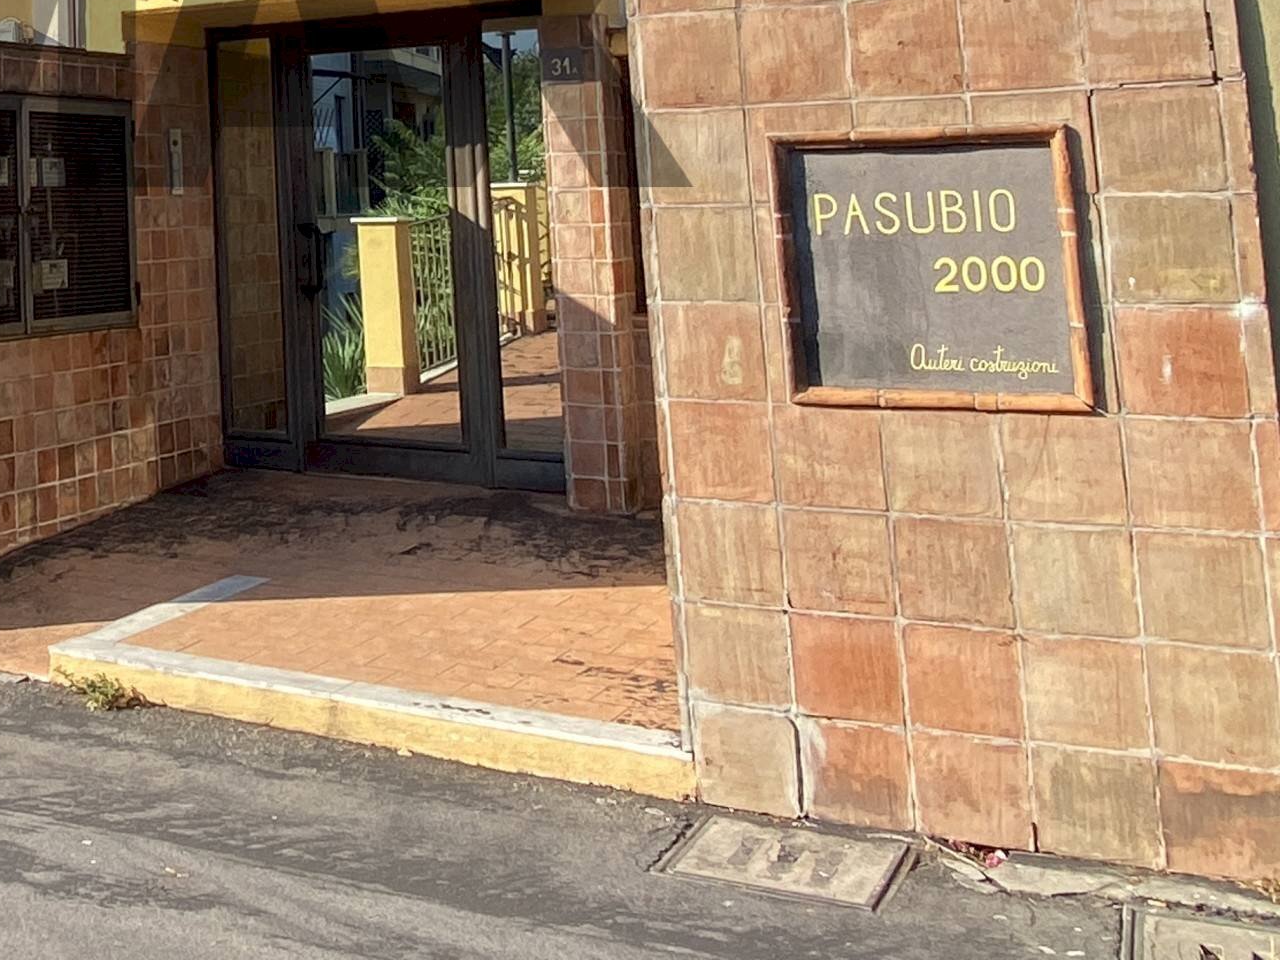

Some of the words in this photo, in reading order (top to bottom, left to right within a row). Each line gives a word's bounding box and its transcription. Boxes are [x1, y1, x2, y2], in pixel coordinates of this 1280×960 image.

[813, 189, 1016, 236] PASUBIO
[933, 255, 1046, 293] 2000
[910, 343, 965, 372] Auteri
[970, 345, 1060, 380] costruzioni
